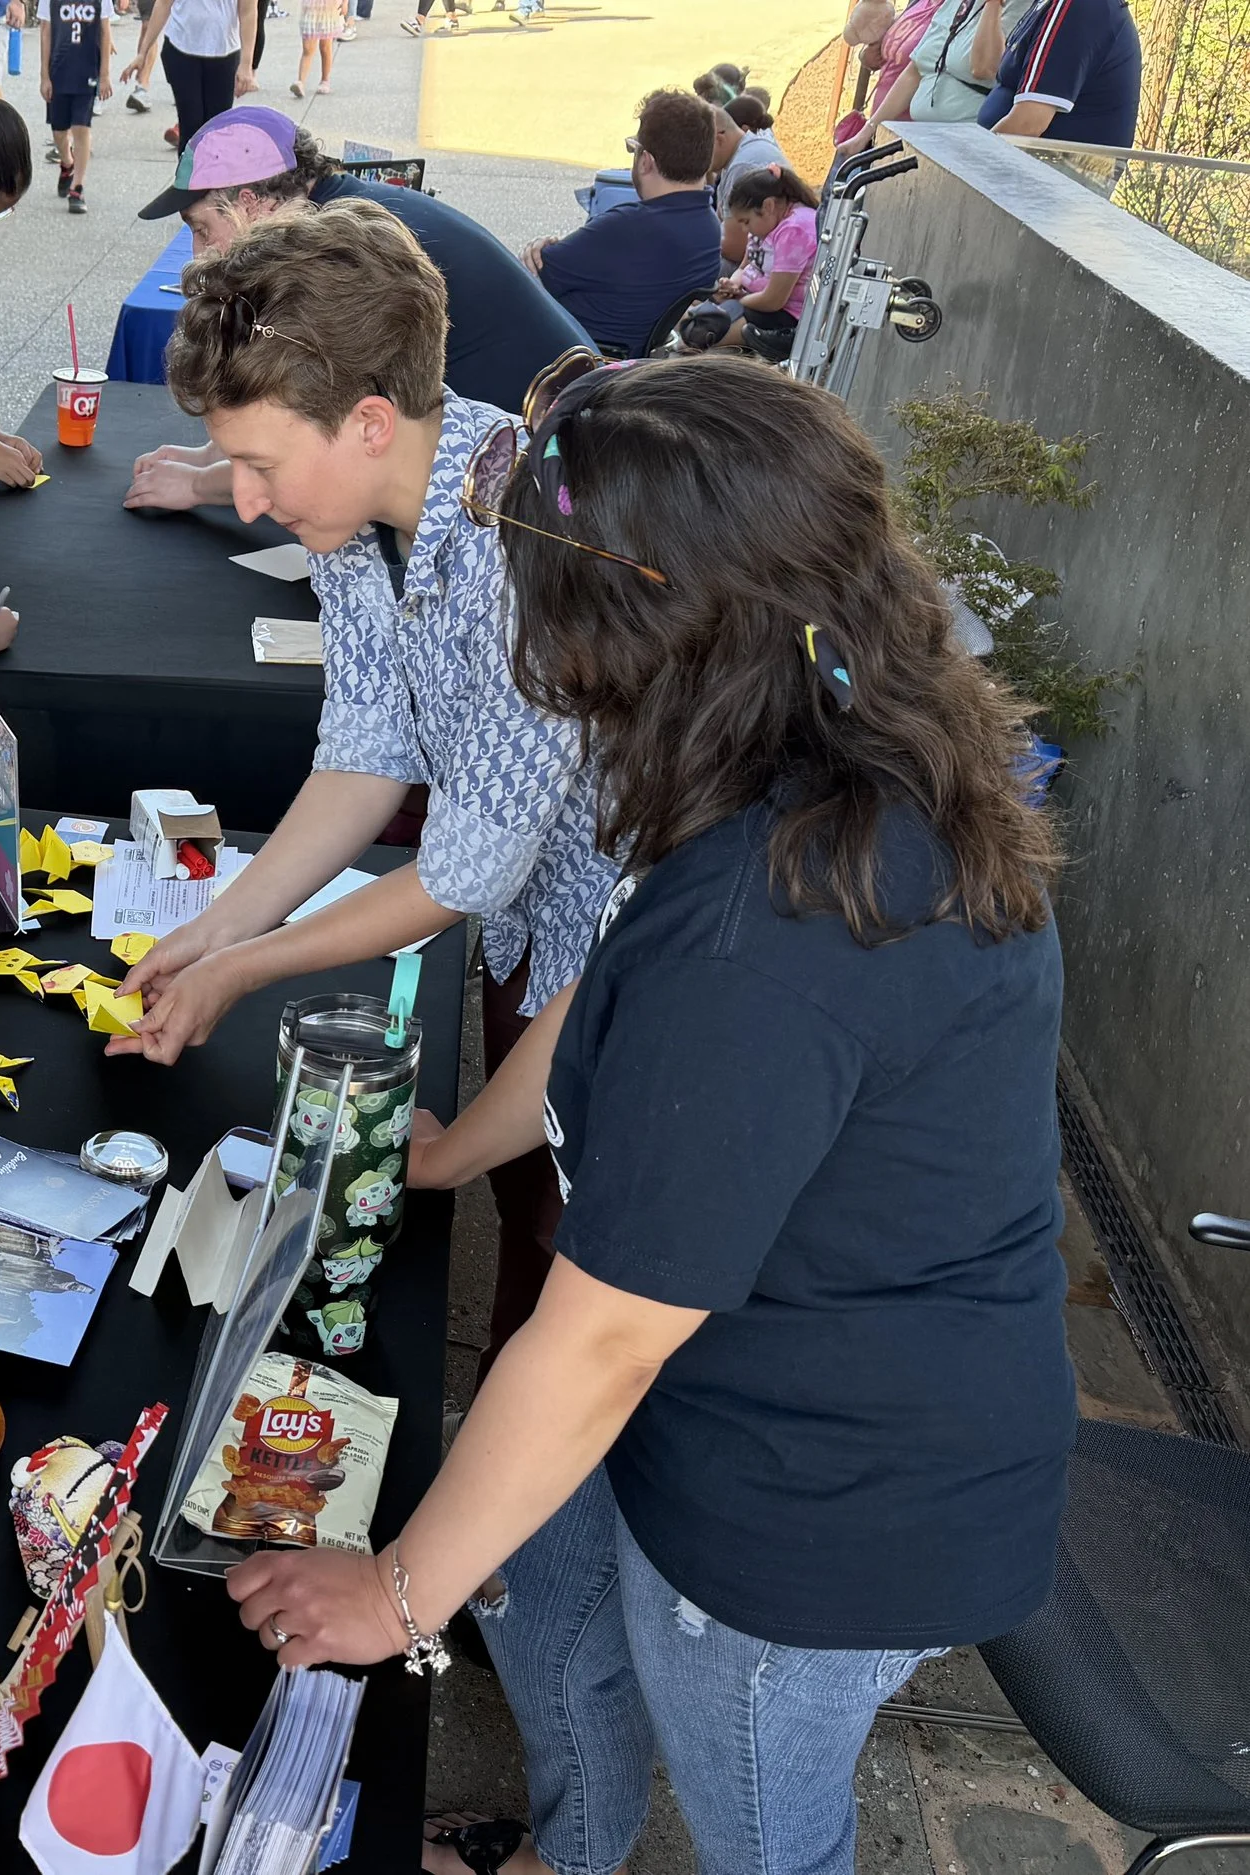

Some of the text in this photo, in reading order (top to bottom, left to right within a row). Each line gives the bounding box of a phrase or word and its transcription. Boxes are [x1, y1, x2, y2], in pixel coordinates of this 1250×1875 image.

[60, 4, 95, 21] OKC
[71, 21, 81, 44] 2
[73, 396, 97, 417] QT
[259, 1406, 321, 1441] Lay's
[250, 1446, 313, 1471] KETTLE
[253, 1471, 287, 1481] MESQUITE
[344, 1531, 356, 1541] NET
